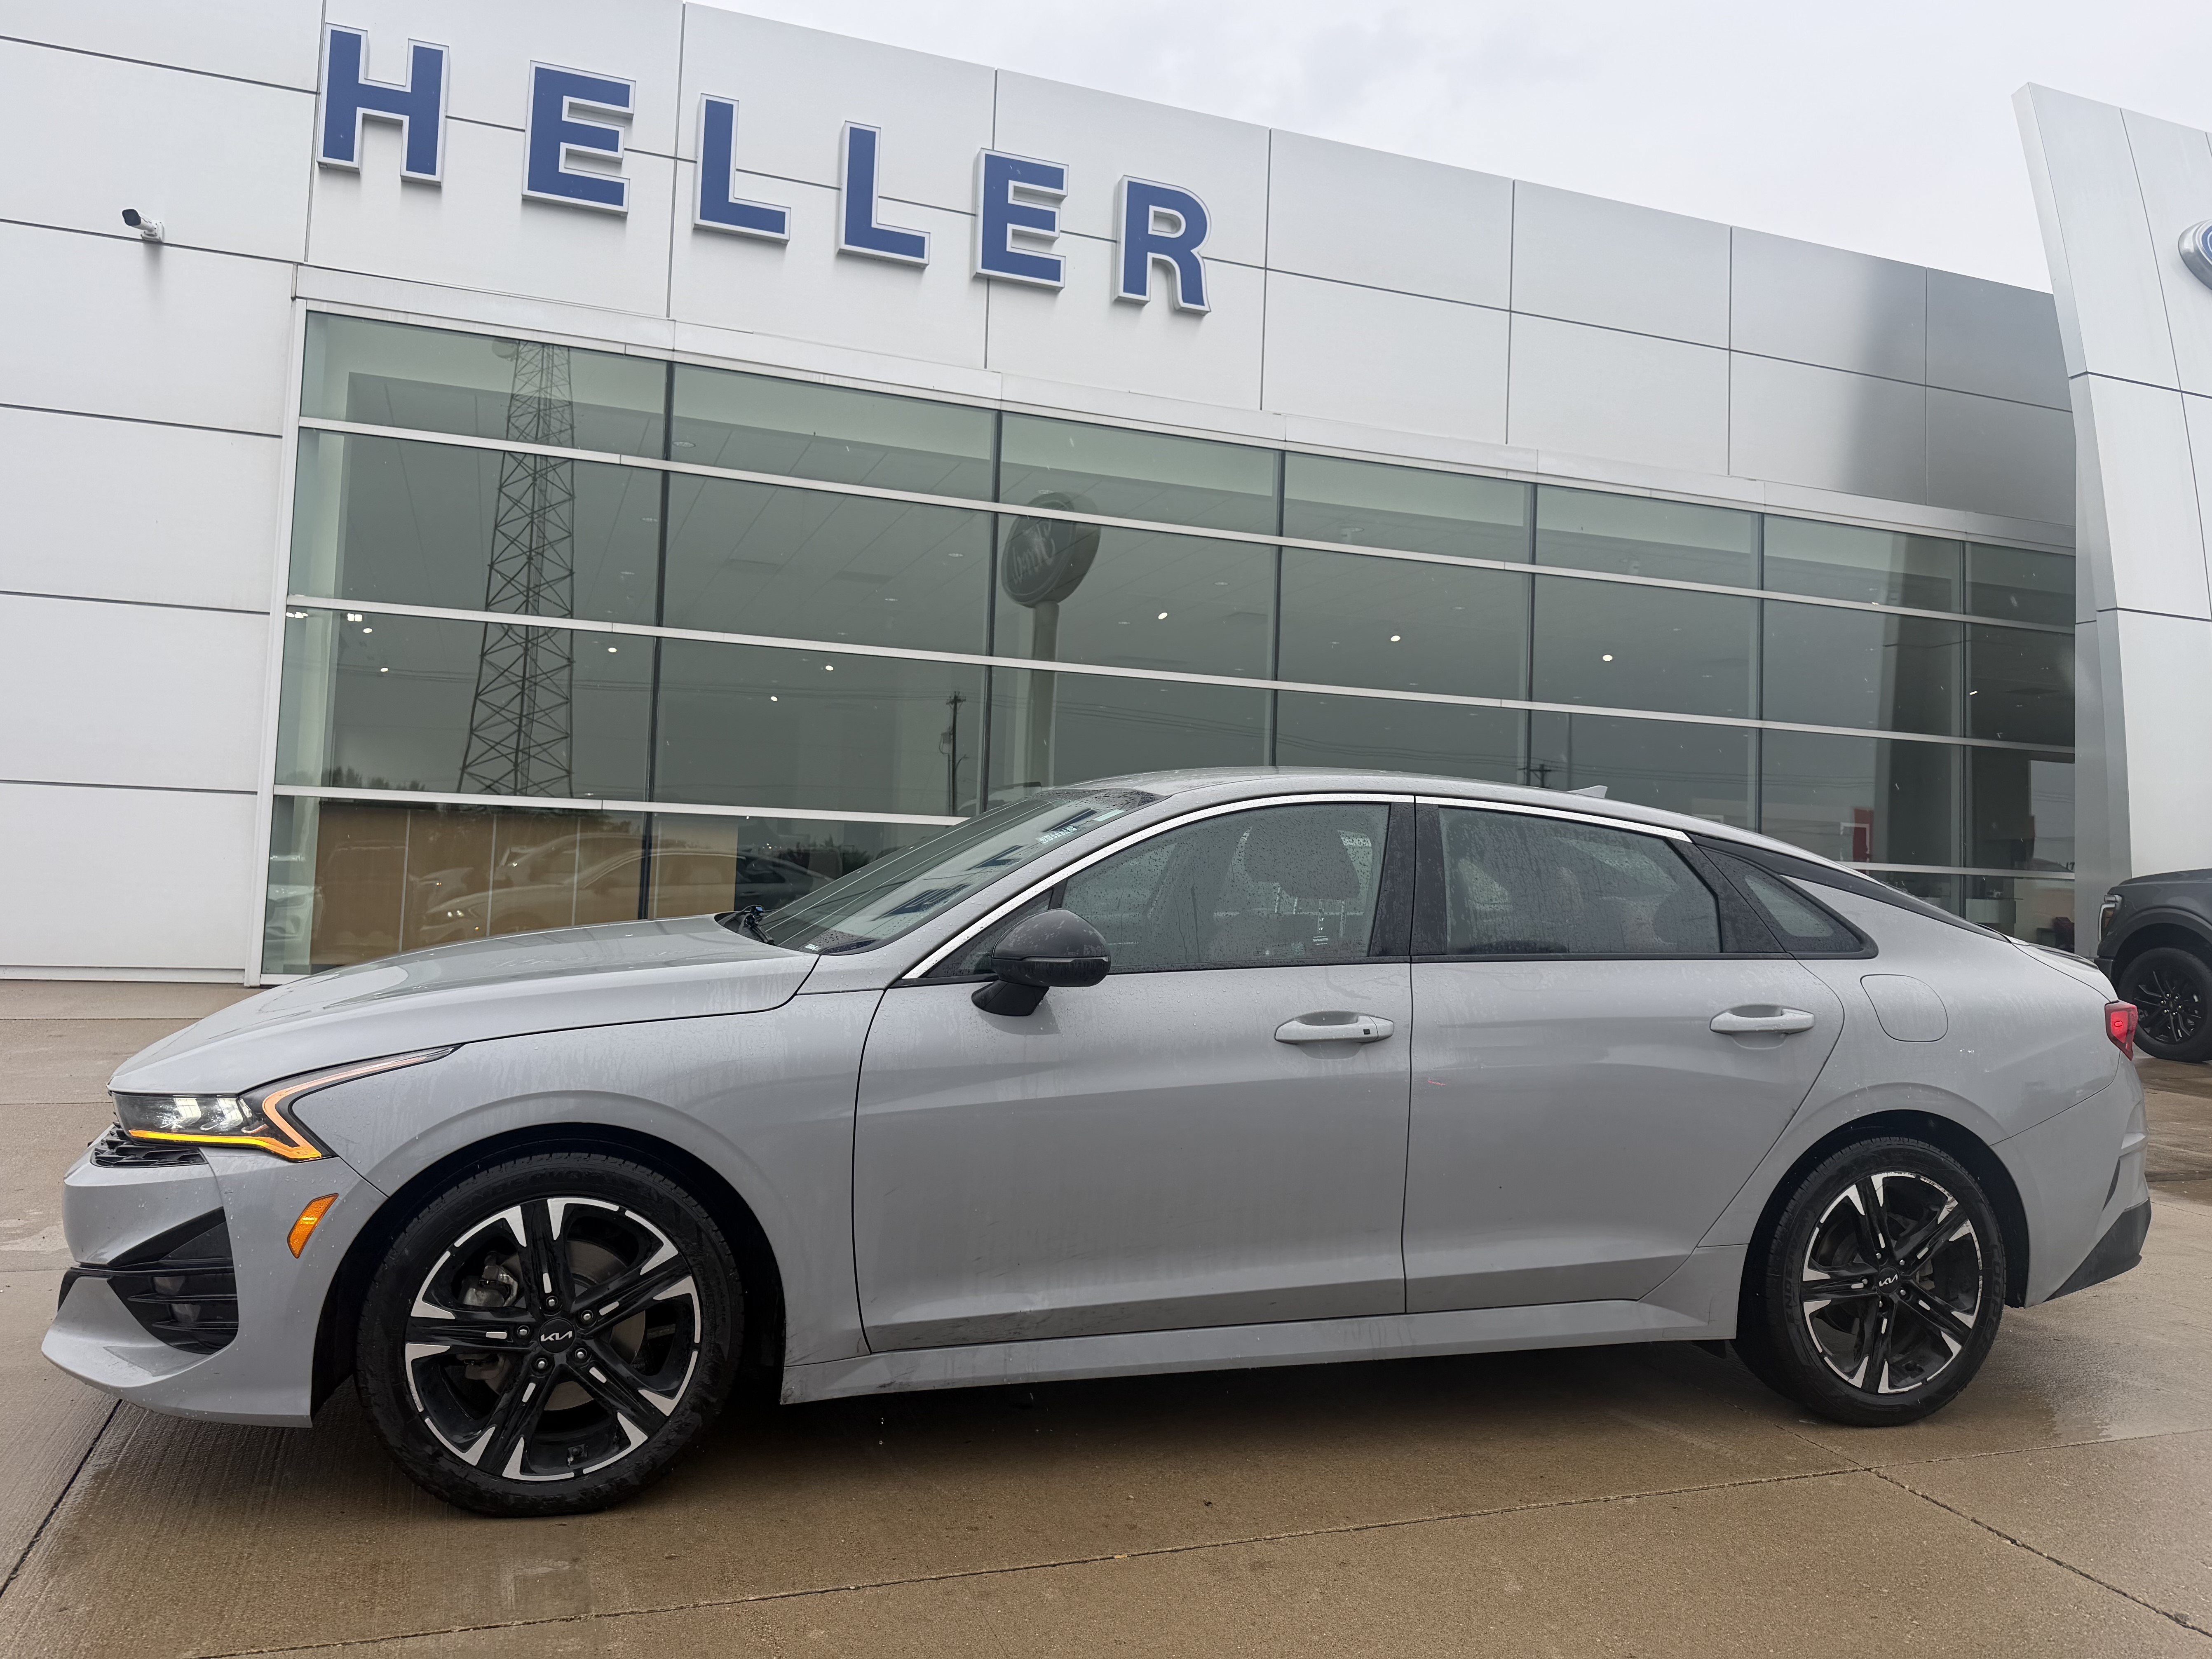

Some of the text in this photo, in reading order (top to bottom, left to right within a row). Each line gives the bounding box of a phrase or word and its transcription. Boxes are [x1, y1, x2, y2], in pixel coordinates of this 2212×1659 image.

[317, 22, 1213, 315] HELLER
[1879, 1274, 1898, 1287] KIA
[1977, 1244, 2001, 1352] COOPER
[541, 1330, 572, 1342] KIA
